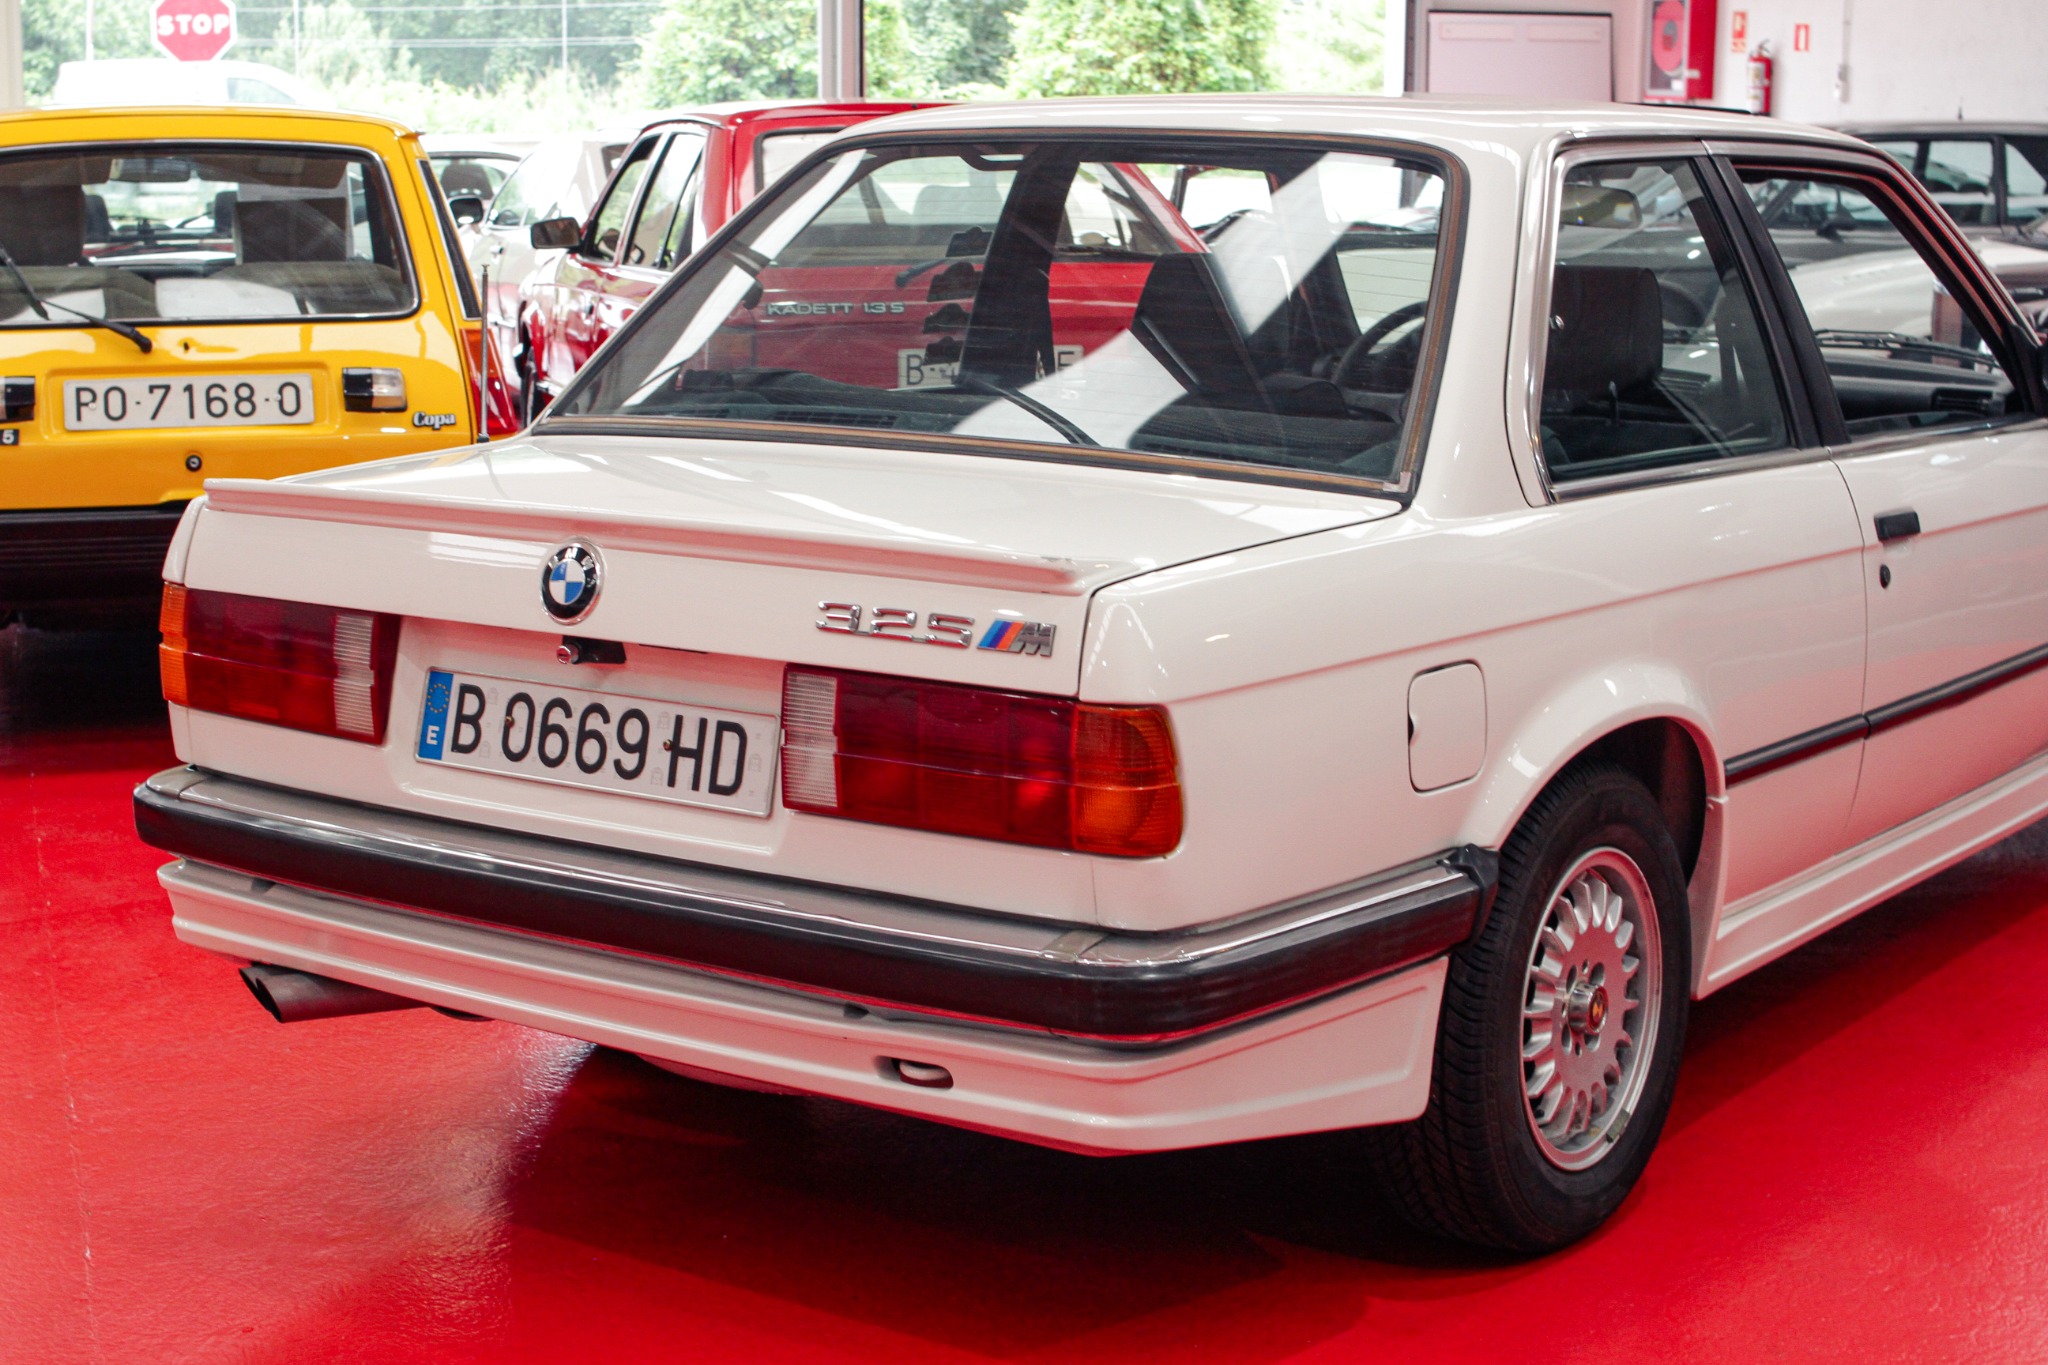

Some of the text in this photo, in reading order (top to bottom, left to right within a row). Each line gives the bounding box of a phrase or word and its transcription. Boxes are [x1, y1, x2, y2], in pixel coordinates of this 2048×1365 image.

[157, 13, 230, 36] STOP
[767, 301, 853, 315] KADETT
[412, 411, 456, 430] Copa
[426, 725, 440, 746] E
[450, 682, 748, 797] B 0669 HD
